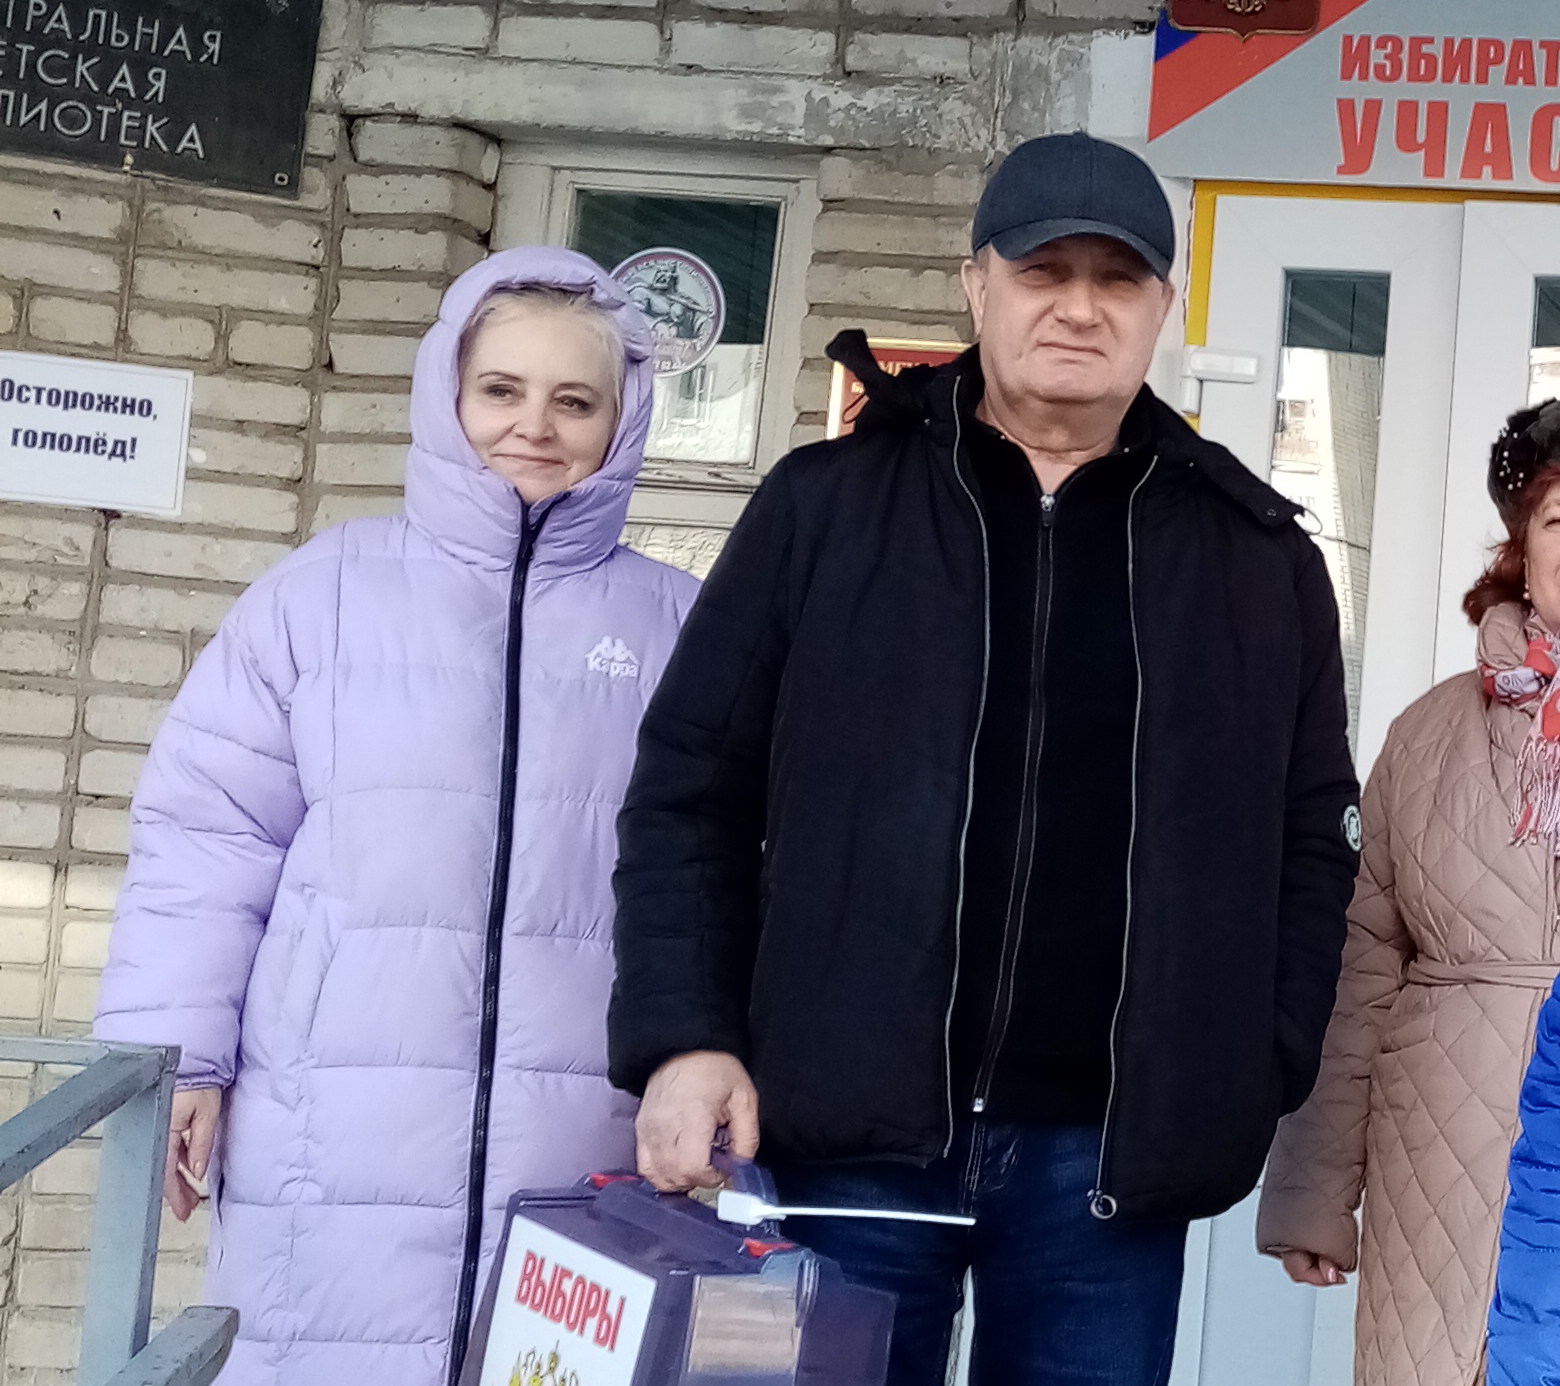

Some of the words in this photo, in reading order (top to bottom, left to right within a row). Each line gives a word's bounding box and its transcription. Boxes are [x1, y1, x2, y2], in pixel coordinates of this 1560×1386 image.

[0, 378, 158, 422] Осторожно,
[11, 427, 138, 462] гололёд!
[586, 655, 640, 679] Kappa
[514, 1250, 628, 1353] ВЫБОРЫ
